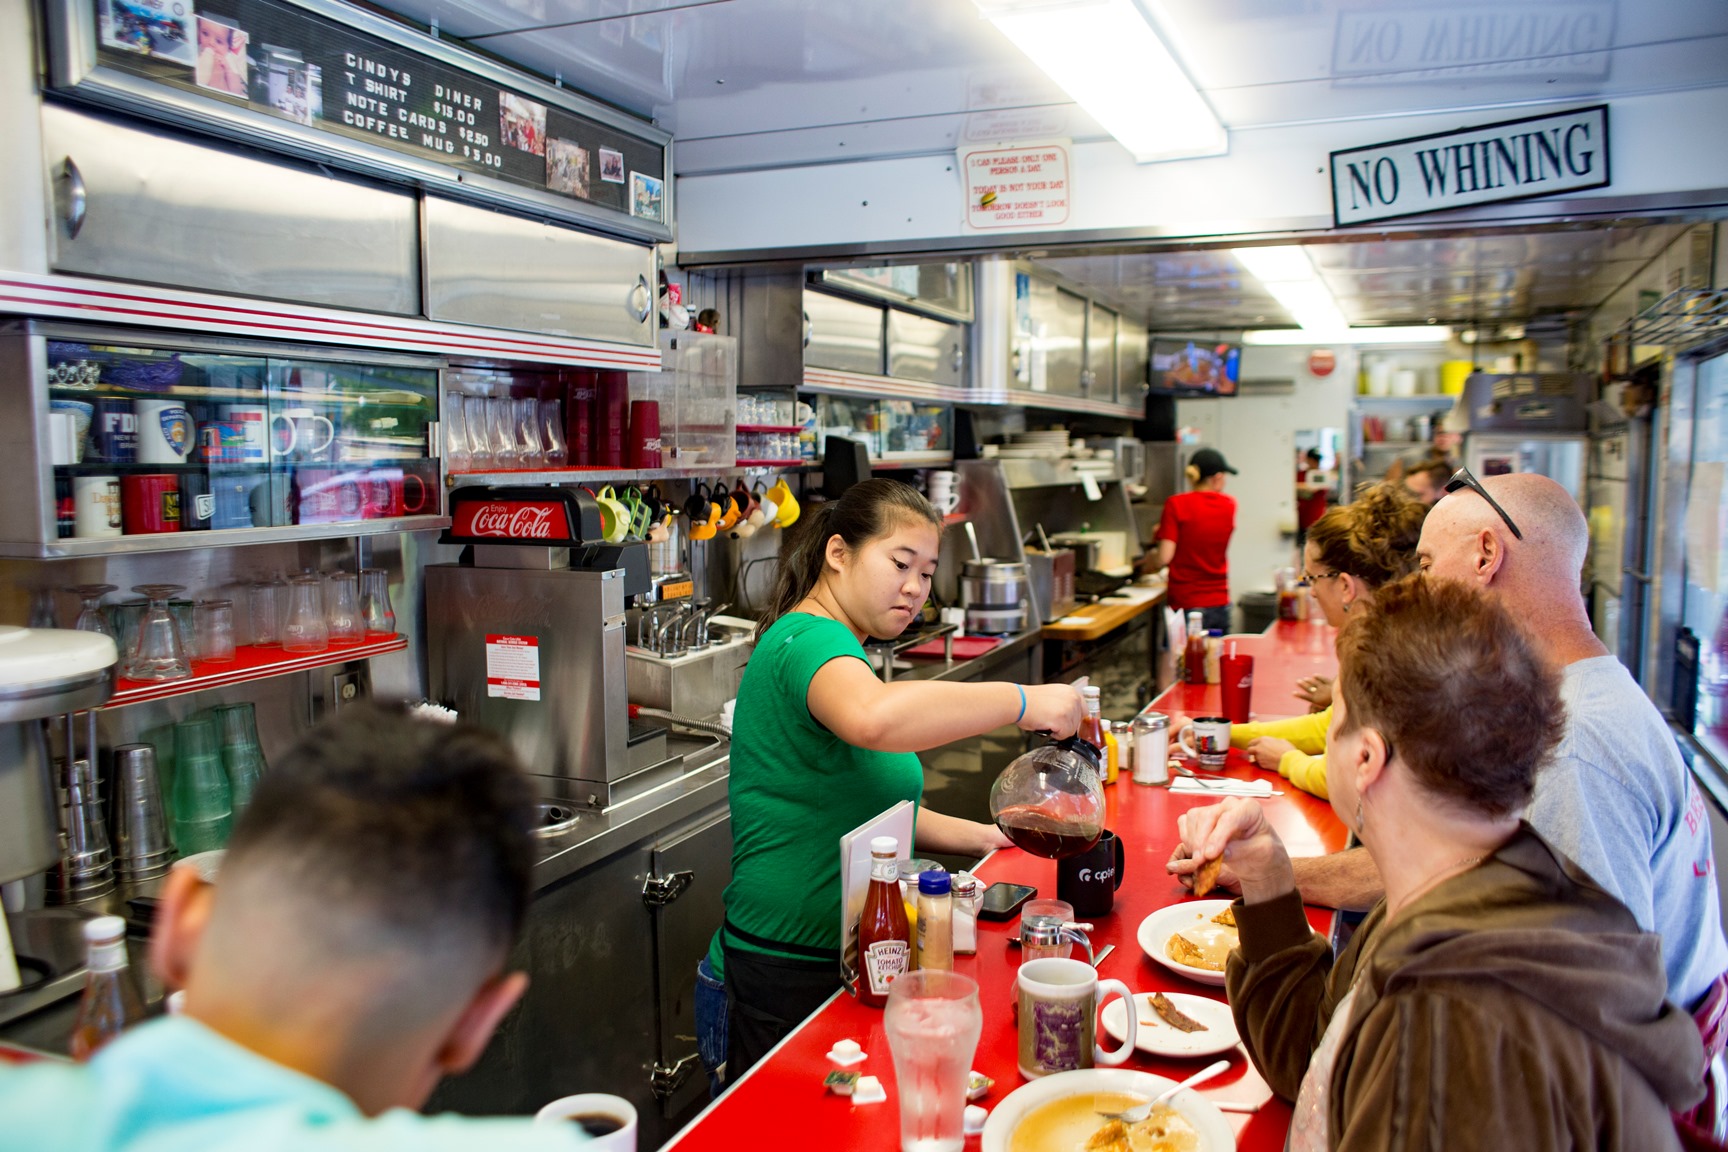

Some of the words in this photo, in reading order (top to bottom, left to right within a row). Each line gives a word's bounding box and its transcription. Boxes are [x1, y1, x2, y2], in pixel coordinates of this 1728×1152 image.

[345, 52, 411, 87] CINDYS
[435, 84, 482, 112] DINER
[345, 71, 356, 86] T
[365, 78, 408, 103] SHIRT
[433, 101, 475, 126] $15.00
[347, 91, 388, 117] NOTE
[398, 108, 447, 134] CARDS
[343, 109, 409, 140] COFFEE
[422, 133, 454, 154] MUG
[993, 156, 1020, 165] PLEASE
[1347, 156, 1400, 210] NO
[1415, 122, 1594, 198] WHINING
[1009, 183, 1024, 192] NOT
[1026, 181, 1047, 191] YOUR
[470, 505, 554, 538] Coca-Cola
[490, 504, 507, 514] Enjoy
[877, 946, 902, 956] HEINZ
[877, 957, 903, 965] TOMATO
